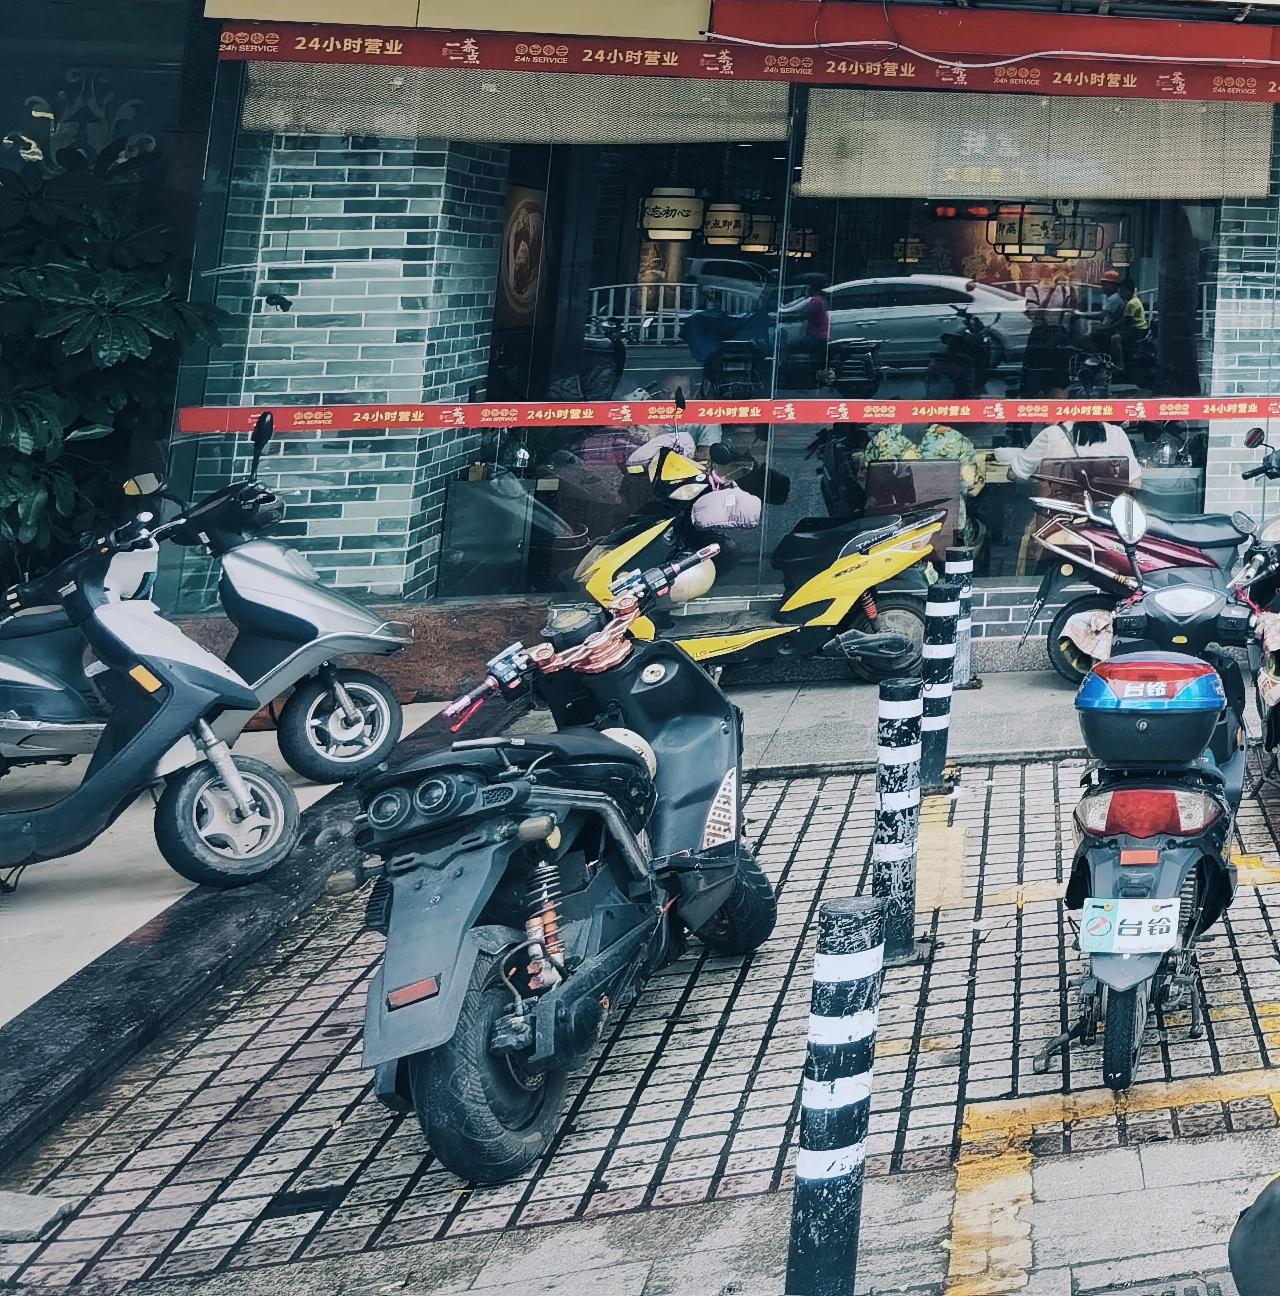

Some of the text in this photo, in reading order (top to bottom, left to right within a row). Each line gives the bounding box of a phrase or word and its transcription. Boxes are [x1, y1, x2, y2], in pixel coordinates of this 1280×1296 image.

[239, 45, 279, 53] SERVICE
[294, 36, 403, 55] 24小时营业
[582, 49, 679, 66] 24小时营业
[826, 61, 916, 77] 24小时营业
[1053, 72, 1138, 88] 24小时营业
[353, 411, 425, 423] 24小时营业
[527, 408, 594, 421] 24小时营业
[699, 406, 761, 418] 24小时营业
